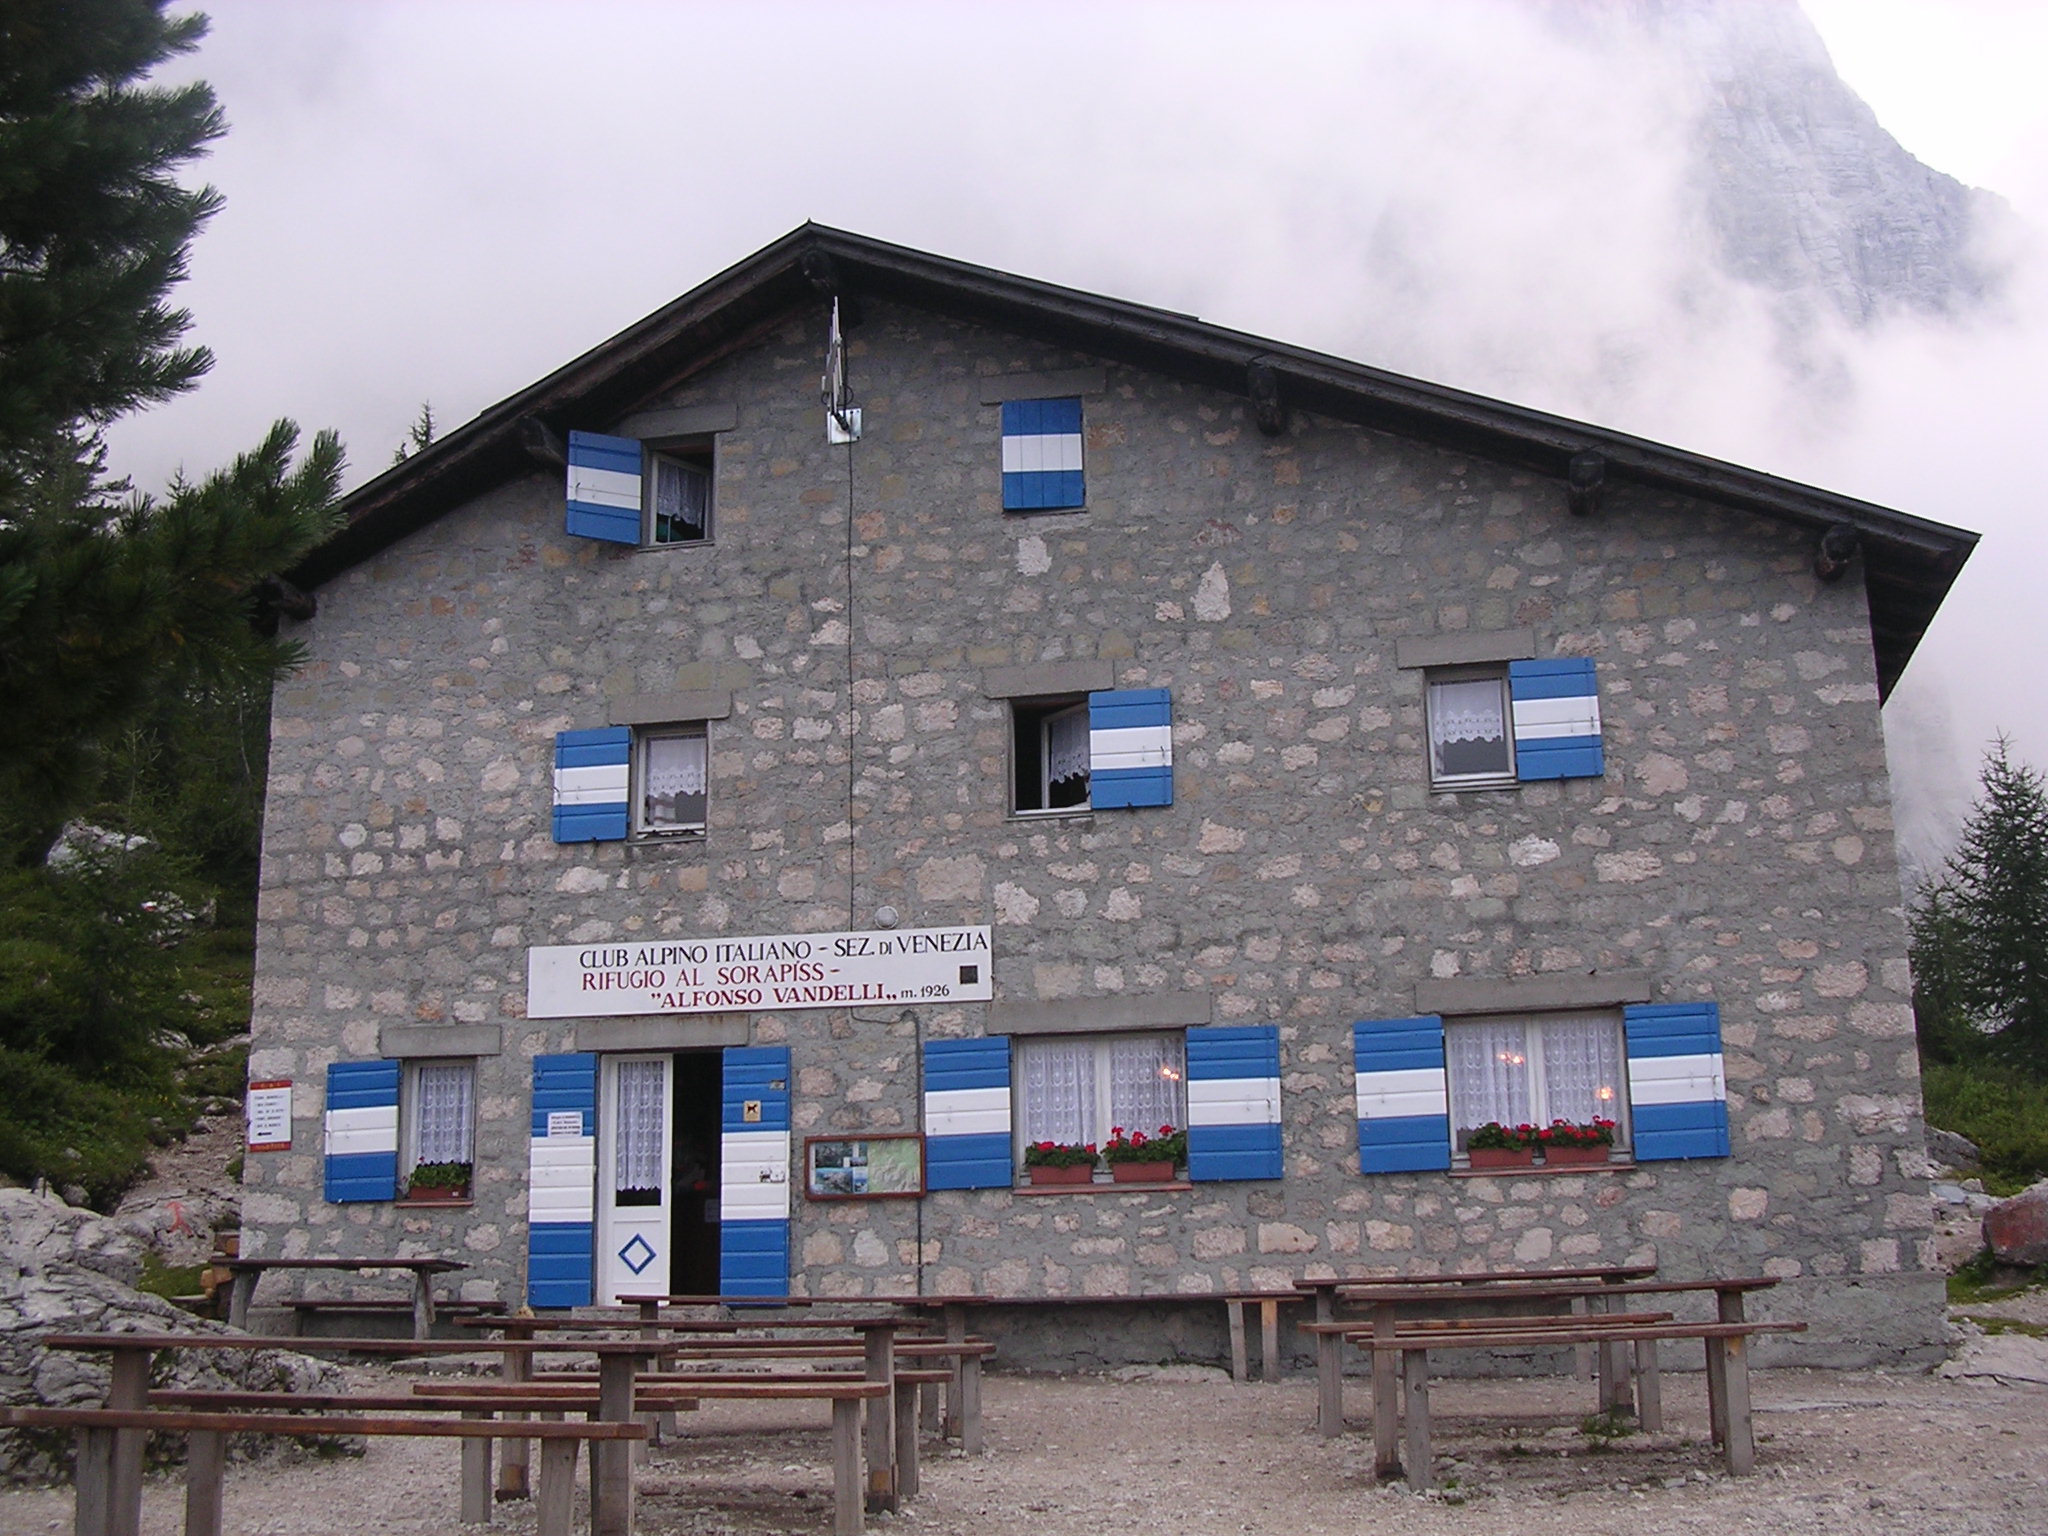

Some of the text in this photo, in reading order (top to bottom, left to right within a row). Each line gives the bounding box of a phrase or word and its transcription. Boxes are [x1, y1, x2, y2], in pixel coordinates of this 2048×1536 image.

[579, 949, 629, 968] CLUB
[635, 945, 708, 967] ALPINO
[716, 941, 811, 963] ITALIANO
[834, 938, 875, 957] SEZ.
[897, 932, 988, 954] VENEZIA
[582, 969, 665, 991] RIFUGIO
[676, 967, 704, 987] AL
[901, 989, 917, 998] m.
[920, 984, 950, 998] 1926
